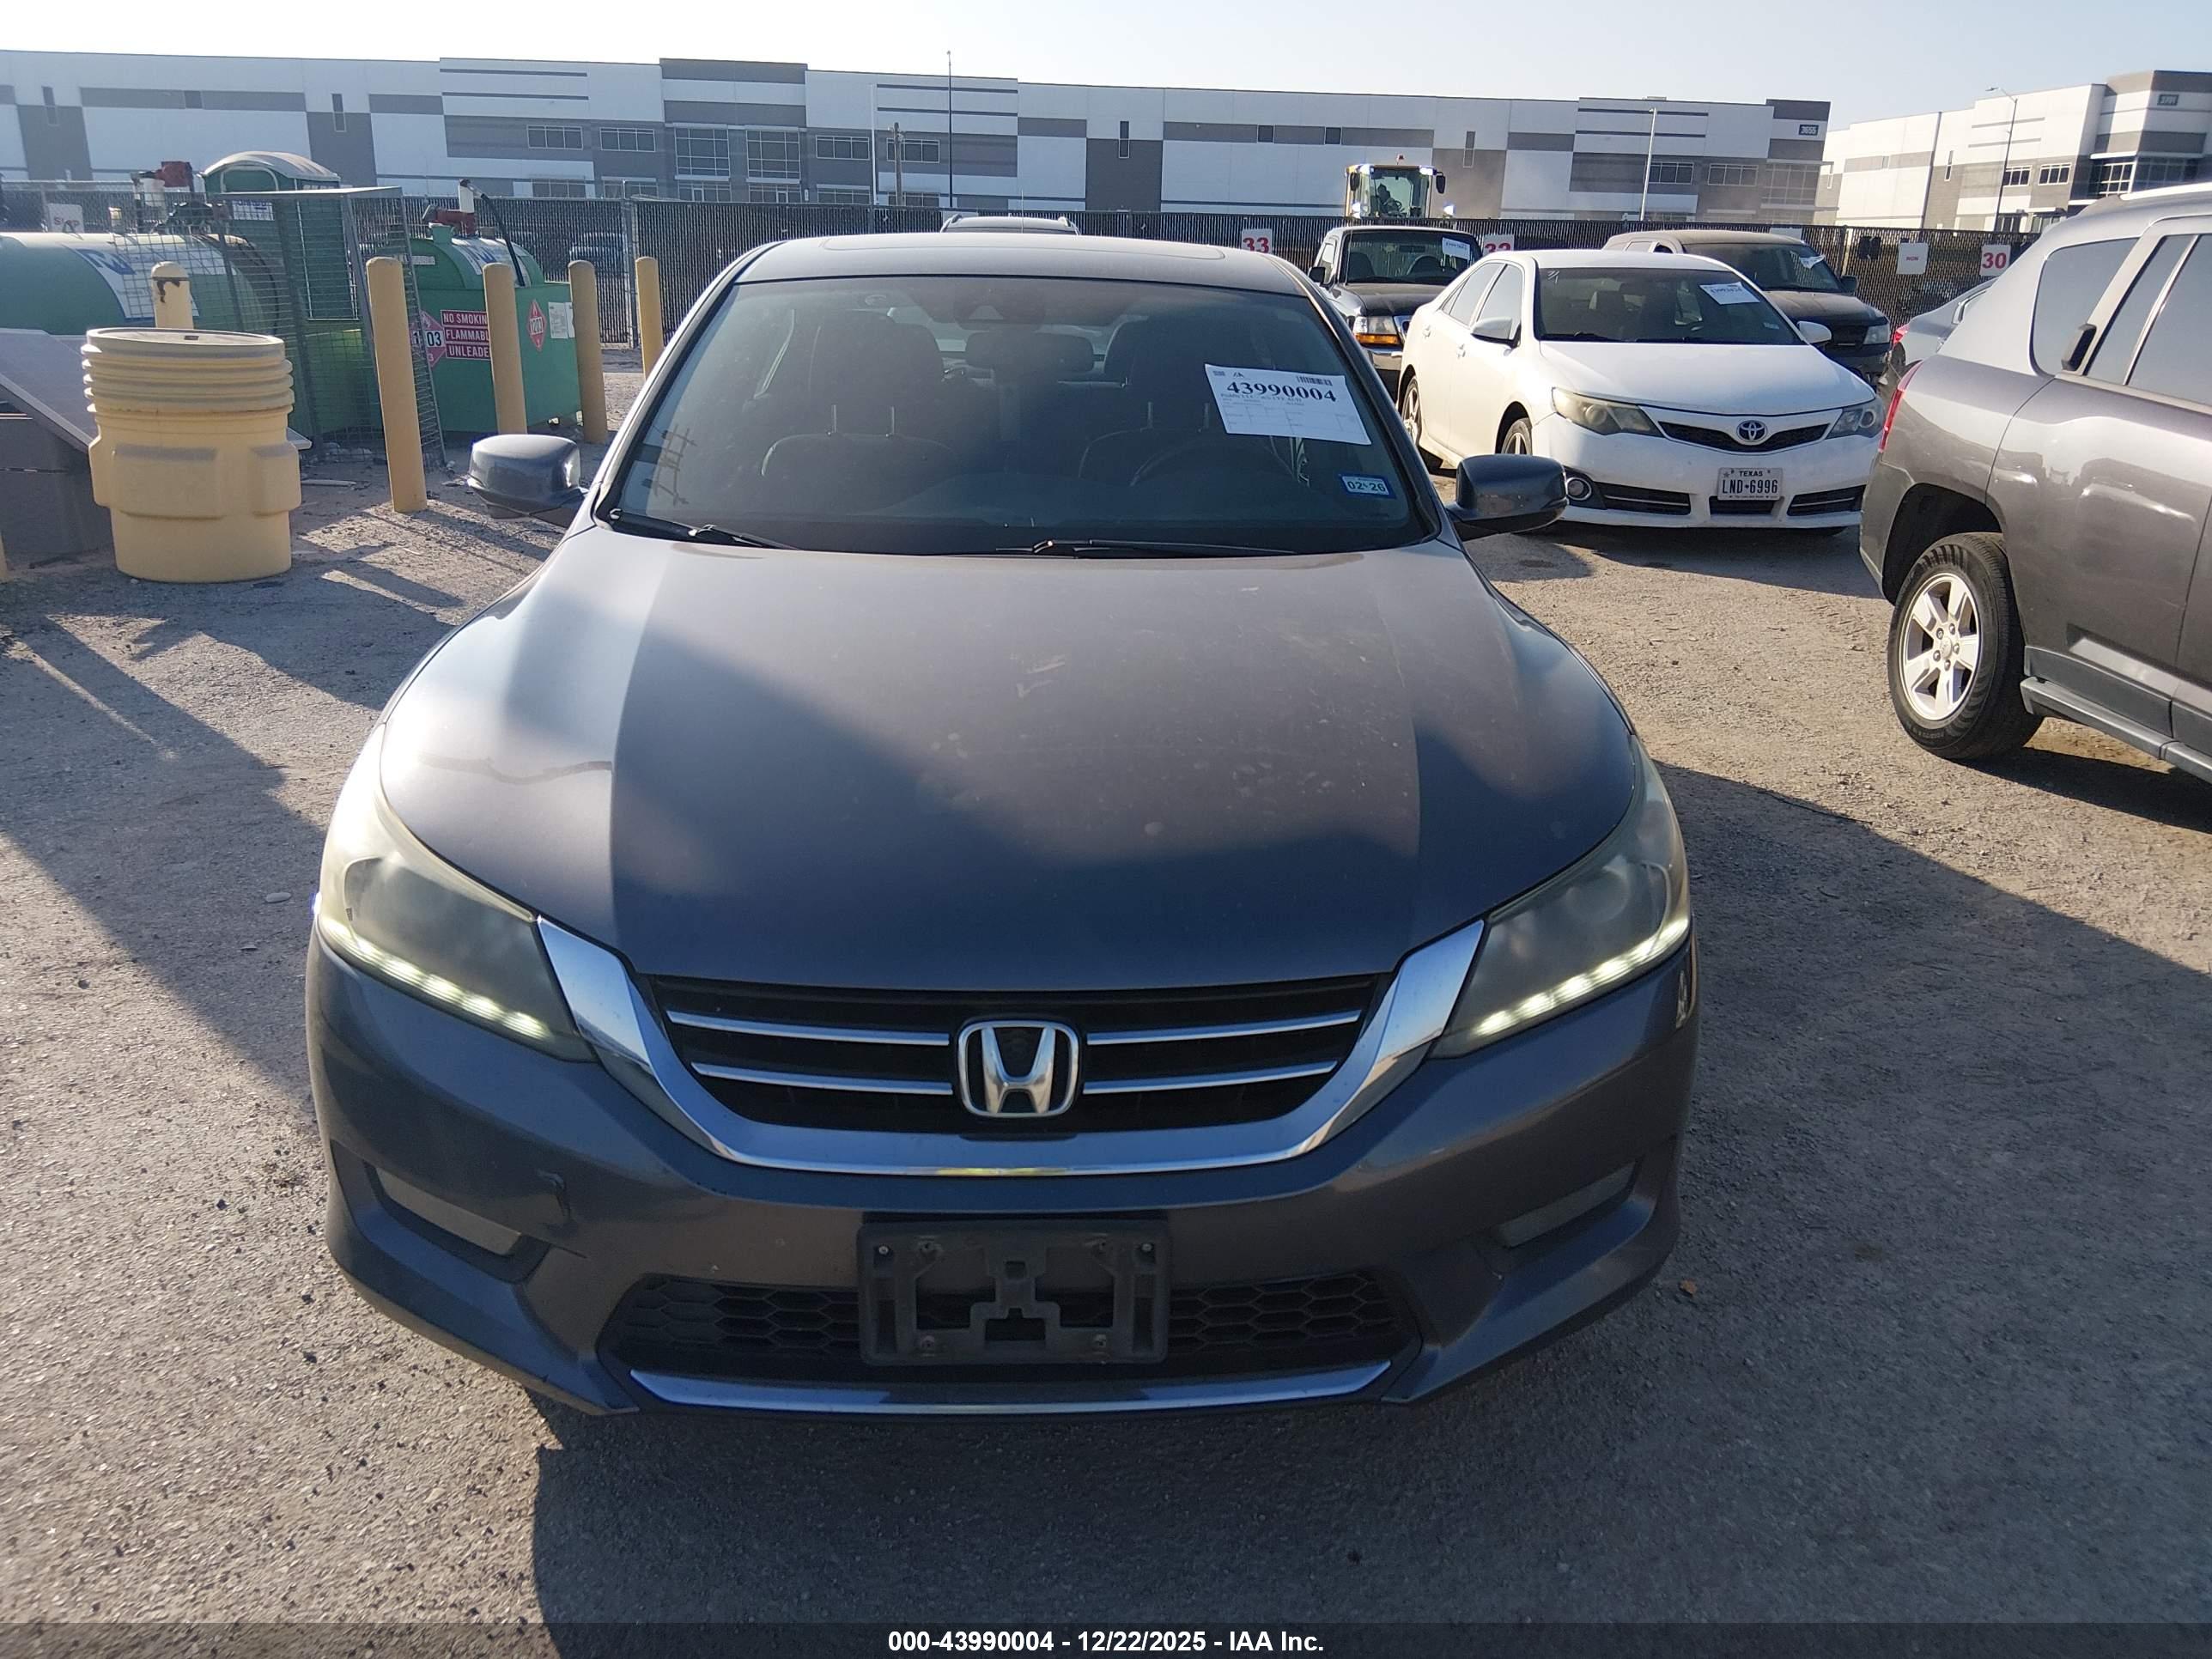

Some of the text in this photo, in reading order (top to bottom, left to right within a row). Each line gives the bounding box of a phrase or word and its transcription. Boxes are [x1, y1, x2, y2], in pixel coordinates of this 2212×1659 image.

[1243, 237, 1269, 253] 33
[1982, 252, 2007, 269] 30
[443, 313, 454, 323] NO
[456, 313, 487, 325] SMOKIN
[413, 331, 441, 346] 103
[447, 330, 489, 341] FLAMMABL
[449, 345, 489, 357] UNLEADE
[1227, 381, 1336, 402] 43990004
